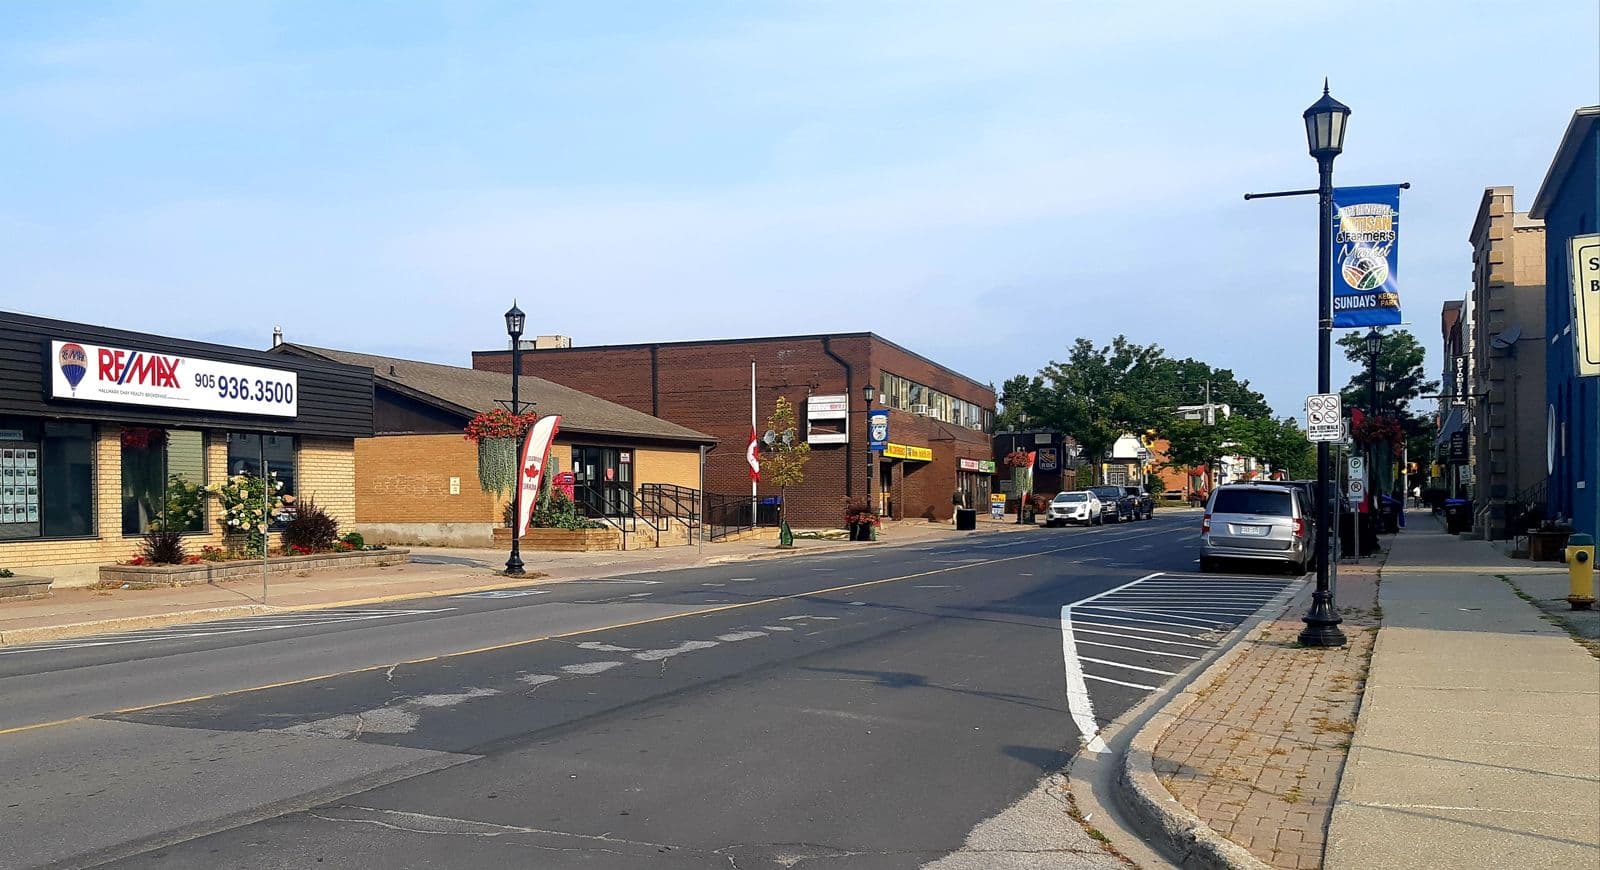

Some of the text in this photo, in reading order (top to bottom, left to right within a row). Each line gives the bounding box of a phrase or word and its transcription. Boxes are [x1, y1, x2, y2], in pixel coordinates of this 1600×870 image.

[1341, 216, 1392, 231] ARTISAN
[1338, 241, 1393, 264] Market
[1335, 294, 1376, 309] SUNDAYS
[98, 348, 180, 389] RE/MAX
[1456, 357, 1464, 402] OPTOMETRY
[195, 373, 293, 404] 905 936.3500
